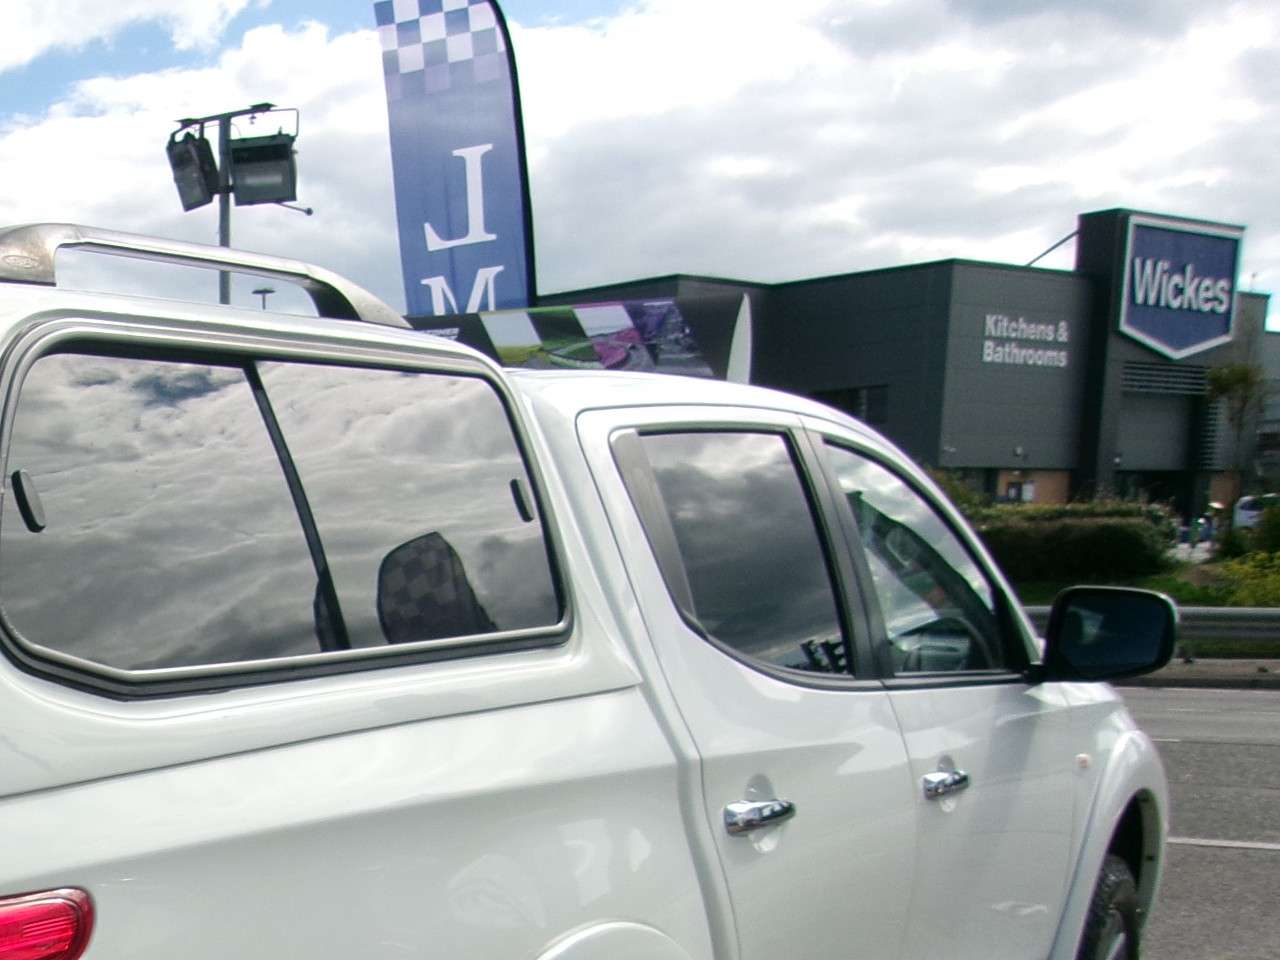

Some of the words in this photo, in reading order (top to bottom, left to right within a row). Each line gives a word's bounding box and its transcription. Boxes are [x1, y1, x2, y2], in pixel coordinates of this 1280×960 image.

[1133, 257, 1231, 314] Wickes
[984, 314, 1055, 341] Kitchens
[1056, 320, 1068, 342] &
[982, 340, 1068, 367] Bathrooms
